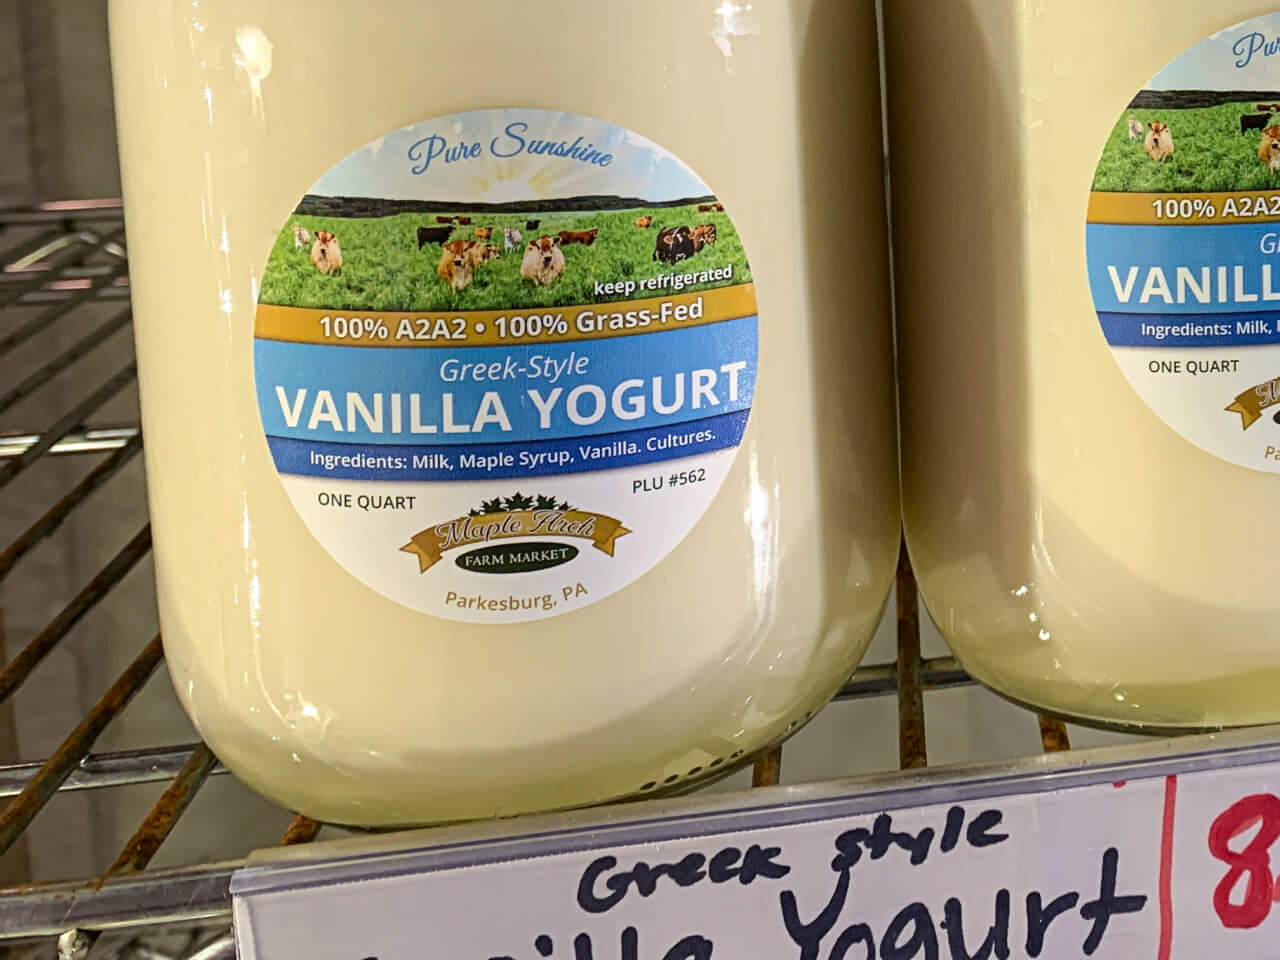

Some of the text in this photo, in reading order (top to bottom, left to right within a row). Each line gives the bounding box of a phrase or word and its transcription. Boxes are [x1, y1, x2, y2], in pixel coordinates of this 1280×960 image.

[408, 121, 613, 175] Pure Sunshine
[1152, 199, 1216, 219] 100%
[594, 264, 733, 297] keep refrigerated
[320, 297, 703, 340] 100% A2A2 100% Grass-Fed
[1141, 322, 1232, 340] Ingredients:
[1236, 320, 1272, 337] Milk,
[439, 353, 590, 384] Greek-Style
[1148, 359, 1240, 376] ONE QUART
[275, 360, 748, 434] VANILLA YOGURT
[310, 429, 717, 473] Ingredients: Milk, Maple Syrup, Vanilla. Cultures.
[632, 467, 706, 494] PLU #562
[317, 492, 417, 512] ONE QUART
[435, 517, 524, 548] Maple
[464, 547, 570, 567] FARM MARKET
[445, 581, 589, 611] Parkesburg, PA
[577, 844, 791, 913] Greek
